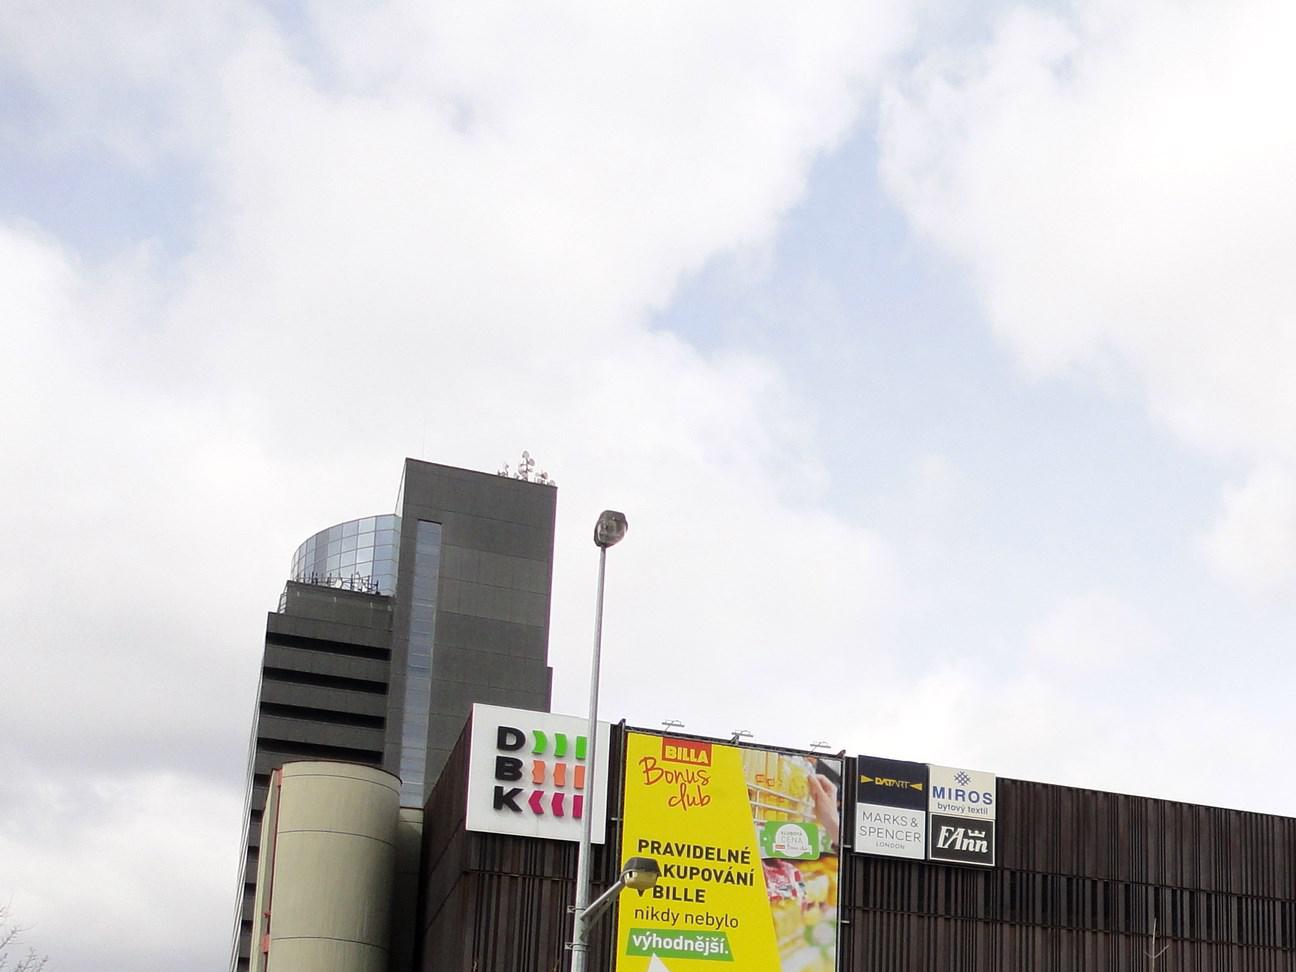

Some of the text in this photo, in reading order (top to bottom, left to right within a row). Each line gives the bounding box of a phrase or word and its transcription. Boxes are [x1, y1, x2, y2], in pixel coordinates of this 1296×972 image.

[664, 745, 709, 764] BILLA
[639, 757, 711, 785] Bonus
[875, 777, 910, 789] DATART
[668, 783, 711, 811] club
[932, 786, 993, 805] MIROS
[937, 802, 988, 815] bytový textil
[863, 811, 919, 827] MARKS &
[859, 826, 921, 843] SPENCER
[638, 839, 751, 864] PRAVIDELNÉ
[876, 842, 905, 850] LONDON
[657, 863, 754, 886] KUPOVÁNÍ
[653, 885, 706, 903] BILLE
[634, 906, 739, 930] nikdy nebylo
[632, 932, 729, 956] výhodnější.
